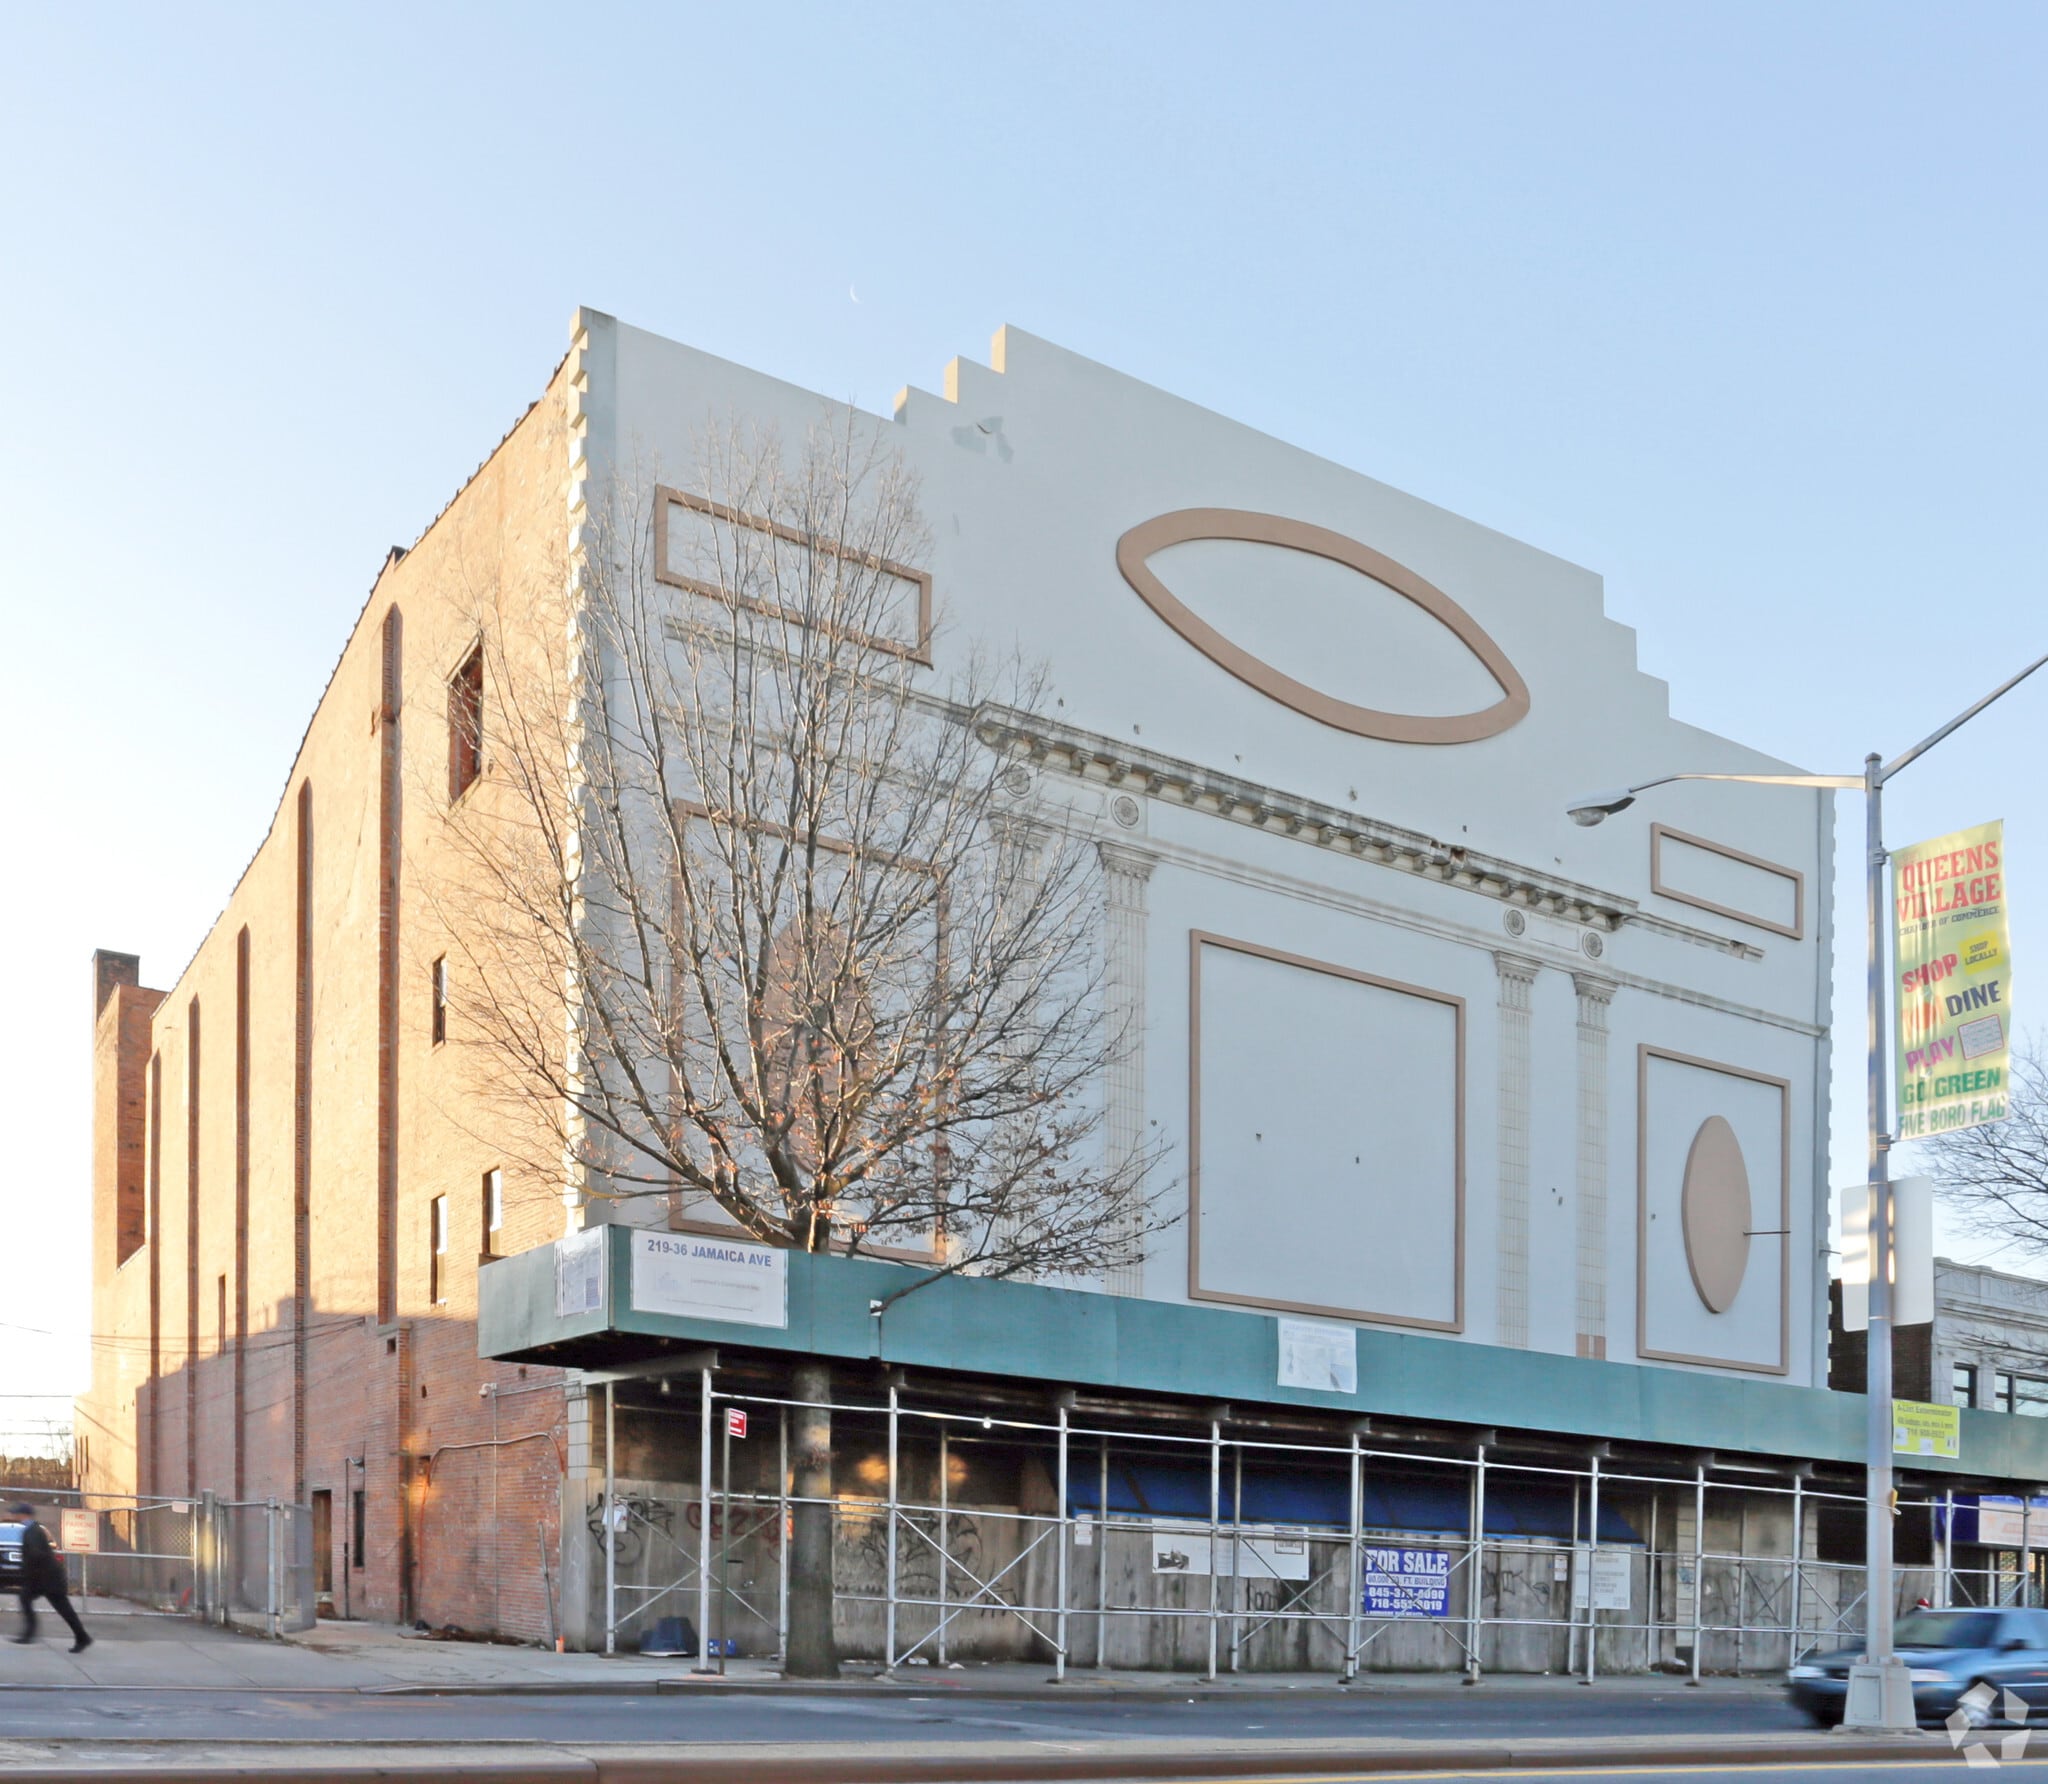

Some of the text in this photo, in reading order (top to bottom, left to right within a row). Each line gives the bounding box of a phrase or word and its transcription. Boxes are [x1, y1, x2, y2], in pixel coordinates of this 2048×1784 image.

[1902, 841, 1999, 893] QUEENS
[1896, 873, 2001, 922] VILLAGE
[1899, 920, 1937, 936] CHAMBR
[1951, 906, 2000, 922] COMMERCE
[1965, 948, 1998, 965] LOCALLY
[1969, 940, 1989, 954] SHOP
[1902, 953, 1958, 993] SHOP
[1945, 980, 2001, 1017] DINE
[1905, 1035, 1954, 1075] PLAY
[1903, 1067, 2001, 1104] GO GREEN
[1898, 1097, 2006, 1137] FIVE BORO FLAG
[647, 1239, 772, 1267] 219-36 JAMAICA AVE
[1365, 1549, 1449, 1574] FOR SALE
[1414, 1577, 1446, 1587] BUILDING
